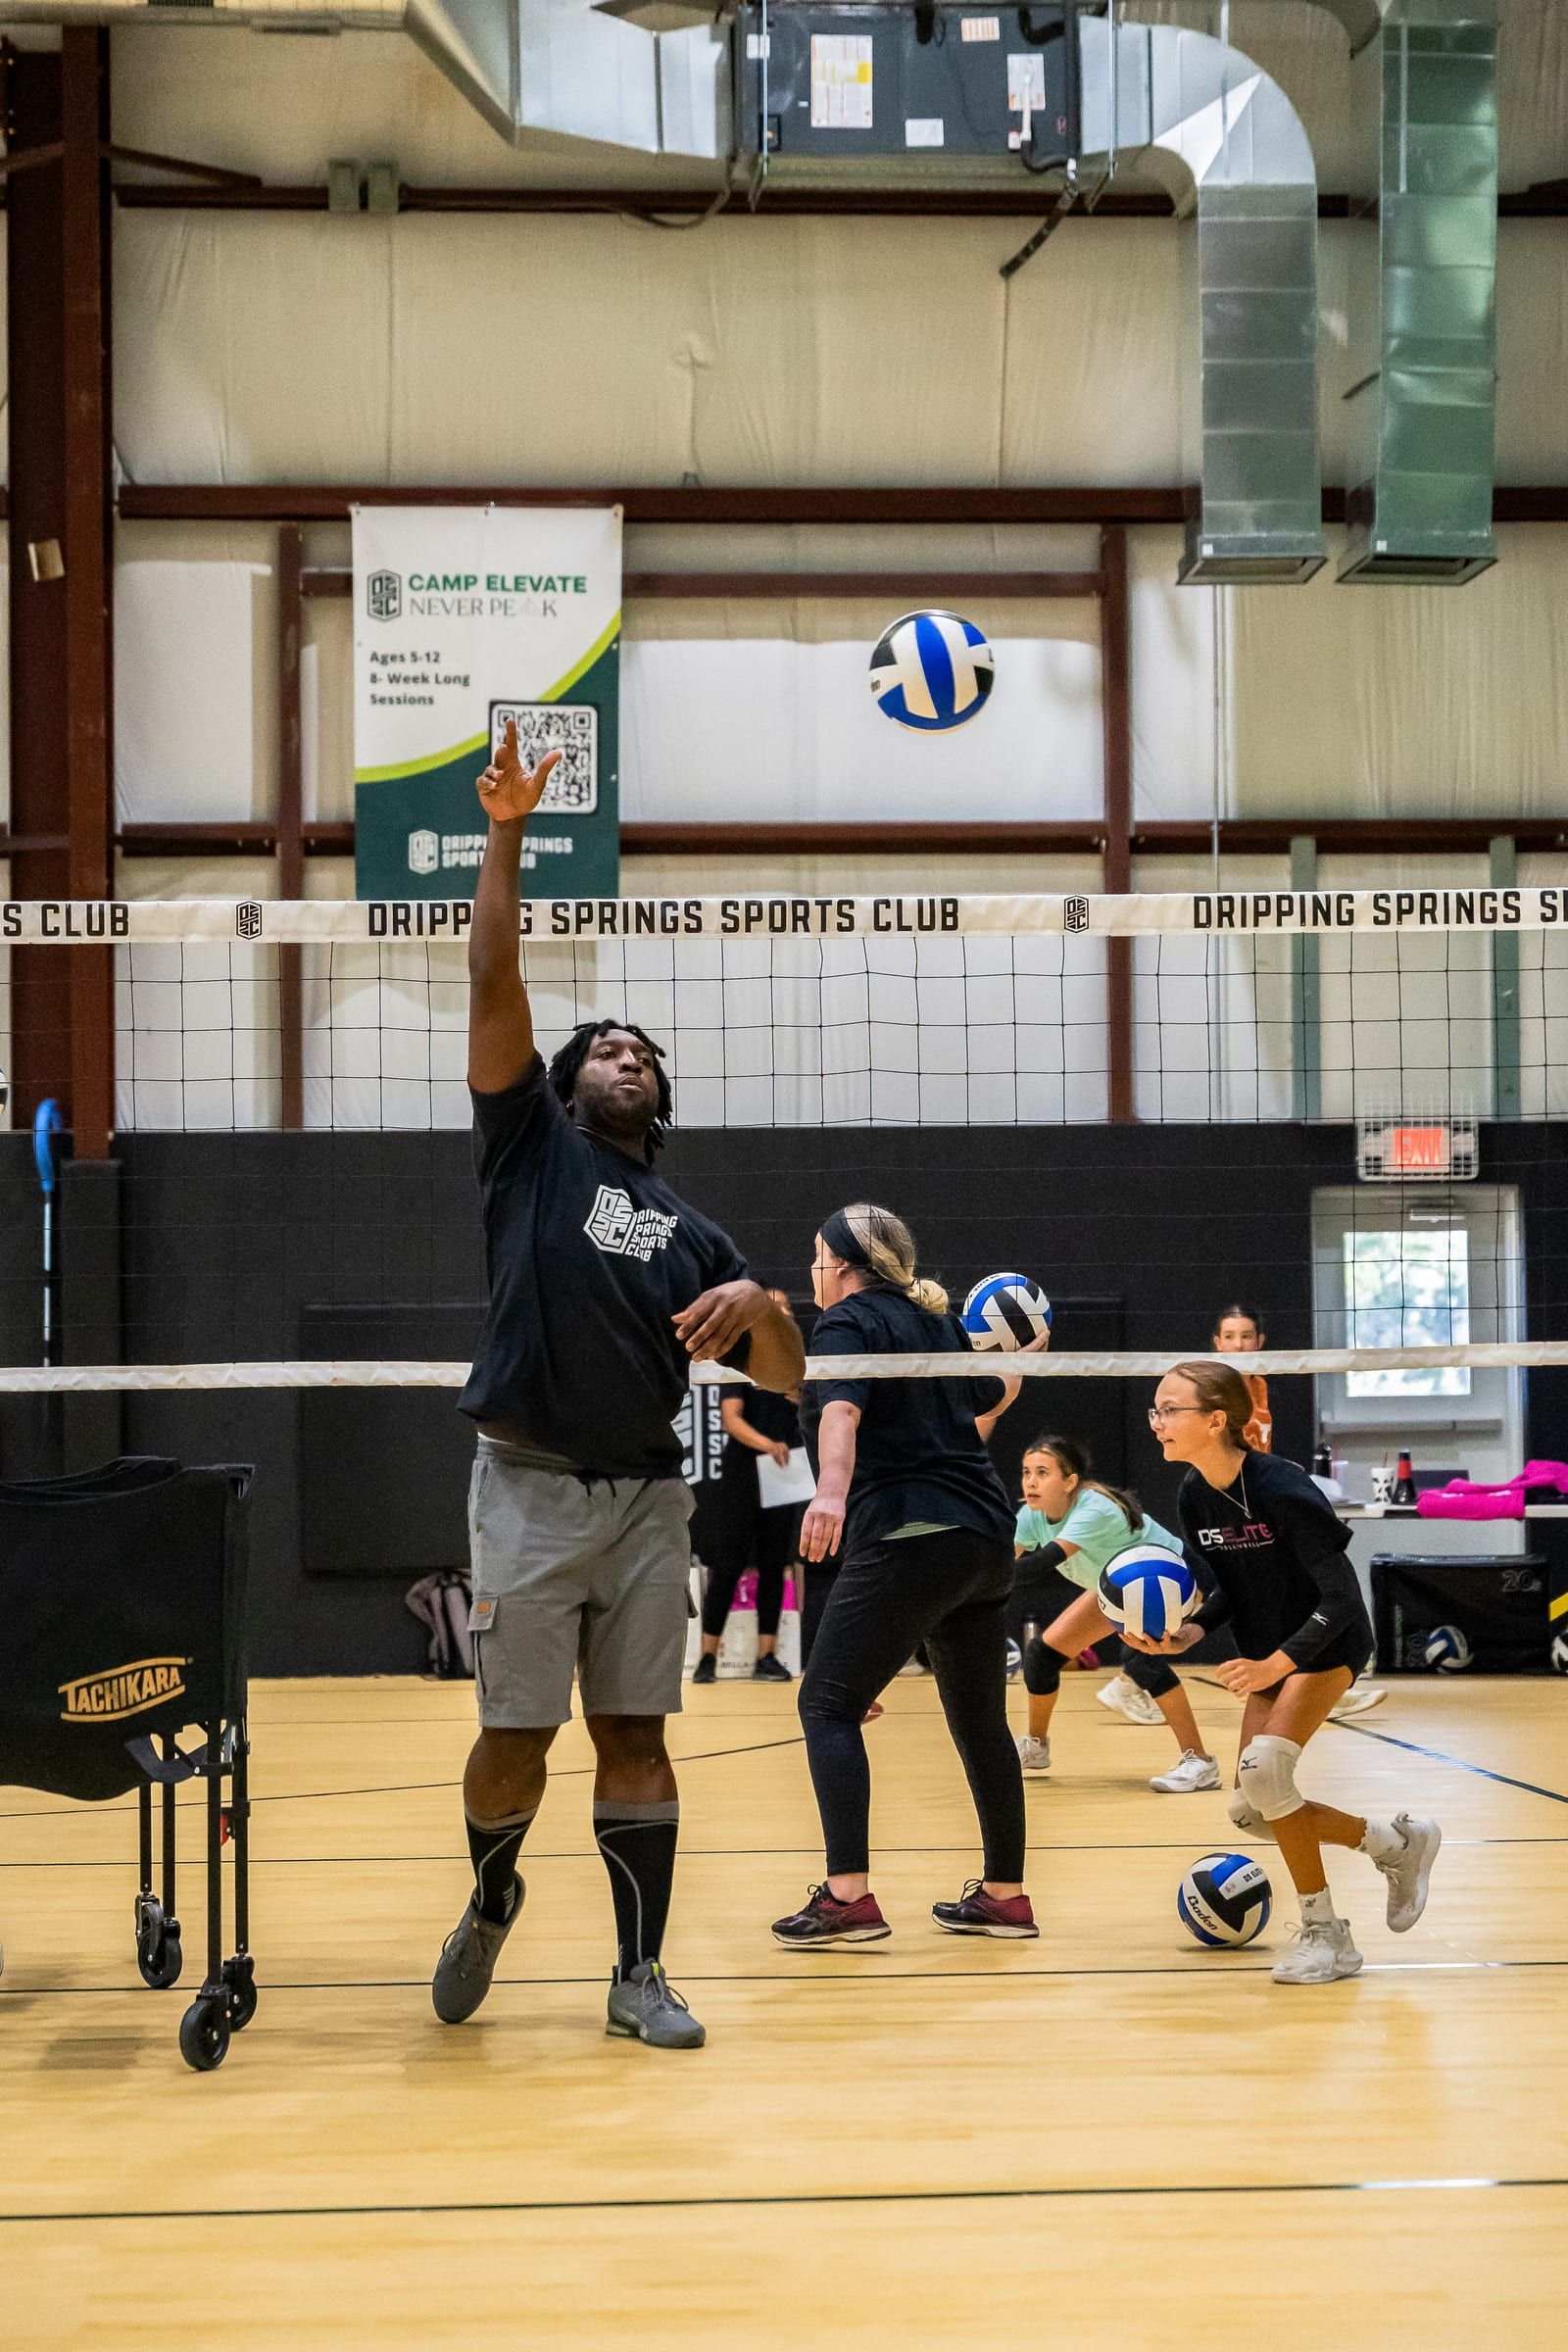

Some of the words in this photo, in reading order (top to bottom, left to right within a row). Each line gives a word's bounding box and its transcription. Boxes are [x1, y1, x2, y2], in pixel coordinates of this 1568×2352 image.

[408, 574, 478, 593] CAMP
[486, 575, 588, 594] ELEVATE
[410, 598, 483, 616] NEVER
[369, 651, 406, 665] Ages
[410, 651, 441, 663] 5-12
[387, 672, 429, 684] Week
[434, 672, 470, 688] Long
[369, 693, 434, 706] Sessions
[442, 835, 488, 851] DRIPPI
[521, 837, 573, 854] PRINGS
[442, 852, 485, 868] SPORT
[368, 902, 532, 937] DRIPPG
[551, 900, 704, 934] SPRINGS
[720, 900, 857, 934] SPORTS
[873, 898, 959, 932] CLUB
[1194, 893, 1354, 929] DRIPPING
[1373, 891, 1522, 926] SPRINGS
[41, 903, 129, 937] CLUB
[1396, 1129, 1443, 1167] EXIT
[635, 1222, 673, 1238] PRINGS
[58, 1657, 185, 1714] TACHIKARA
[1187, 1895, 1218, 1931] Baden
